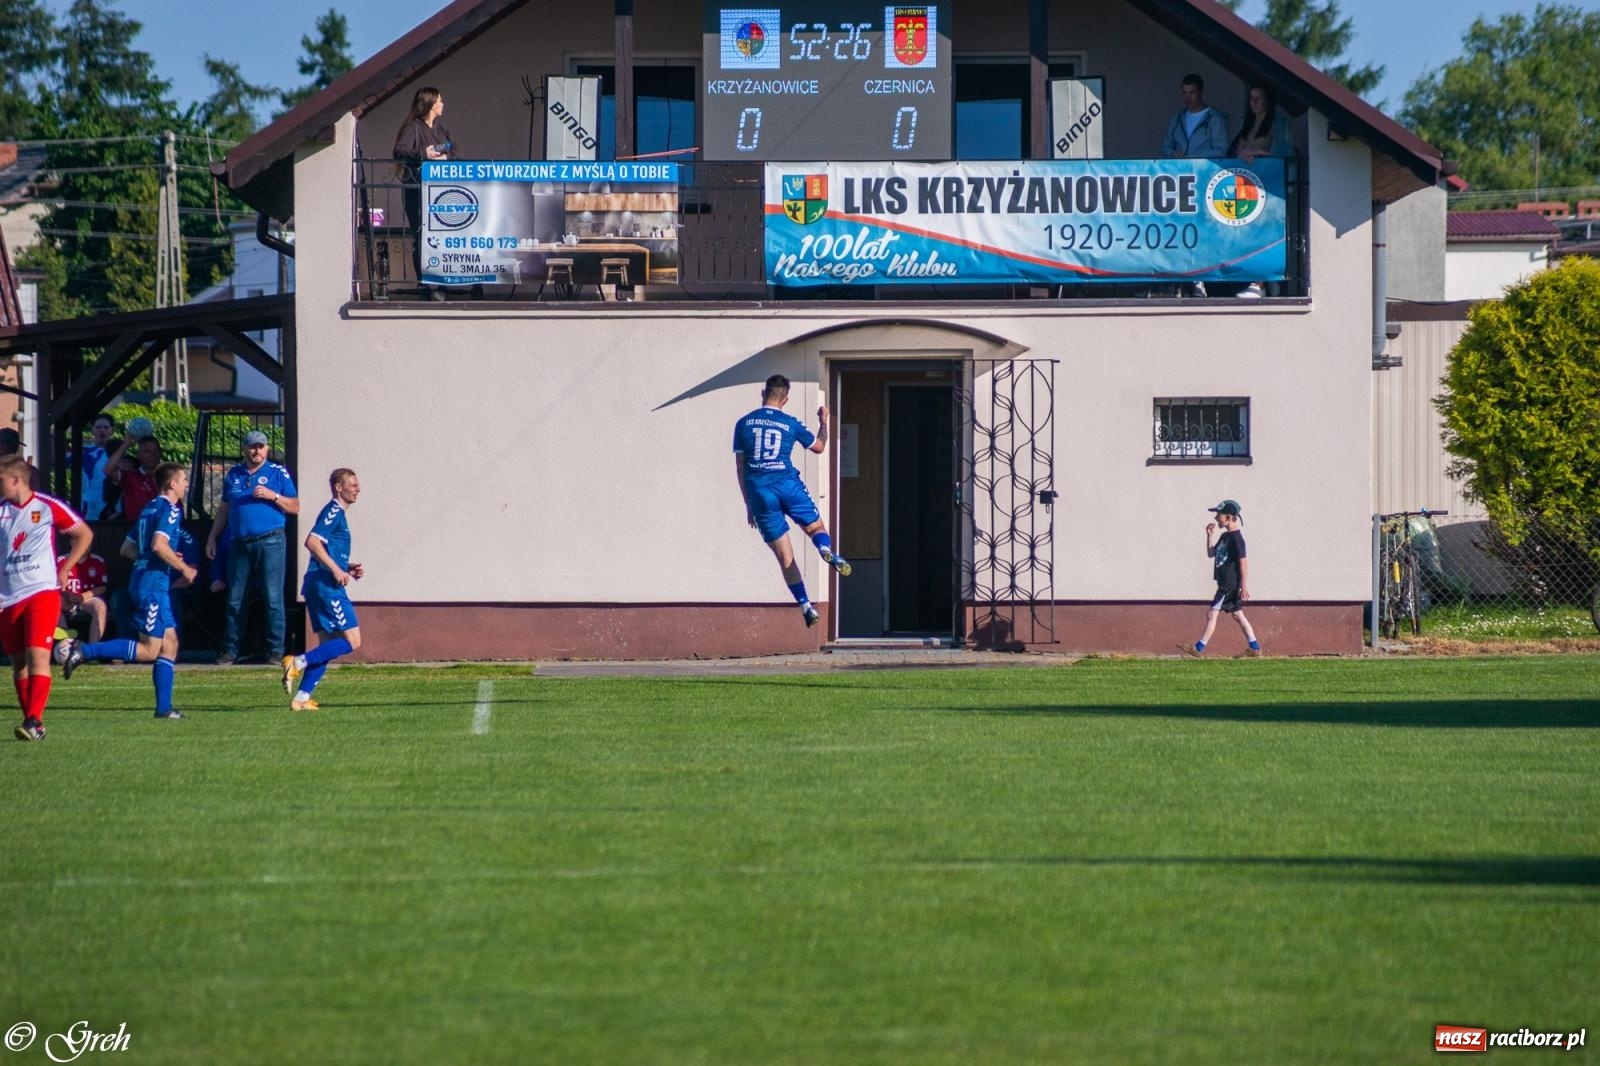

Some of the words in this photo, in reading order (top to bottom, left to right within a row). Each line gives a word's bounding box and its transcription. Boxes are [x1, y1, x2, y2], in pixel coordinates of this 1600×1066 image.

[789, 23, 872, 60] 52:26
[707, 79, 819, 94] KRZYŻANOWICE
[864, 80, 935, 94] CZERNICA
[549, 101, 597, 150] BINGO
[736, 107, 762, 151] 0
[892, 106, 918, 151] 0
[1055, 102, 1101, 154] BINGO
[429, 165, 473, 179] MEBLE
[477, 165, 557, 179] STWORZONE
[561, 165, 571, 179] Z
[572, 162, 615, 181] MYŚLĄ
[619, 166, 627, 179] O
[631, 166, 670, 179] TOBIE
[844, 176, 907, 215] LKS
[918, 170, 1197, 215] KRZYŻANOWICE
[445, 237, 467, 249] 691
[470, 237, 494, 249] 660
[497, 237, 518, 249] 173
[1043, 223, 1199, 250] 1920-2020
[442, 253, 481, 263] SYRYNIA
[442, 264, 457, 273] UL.
[460, 264, 491, 273] 3MAJA
[773, 252, 876, 283] Naszego
[887, 250, 957, 277] Klubu
[752, 427, 782, 460] 19
